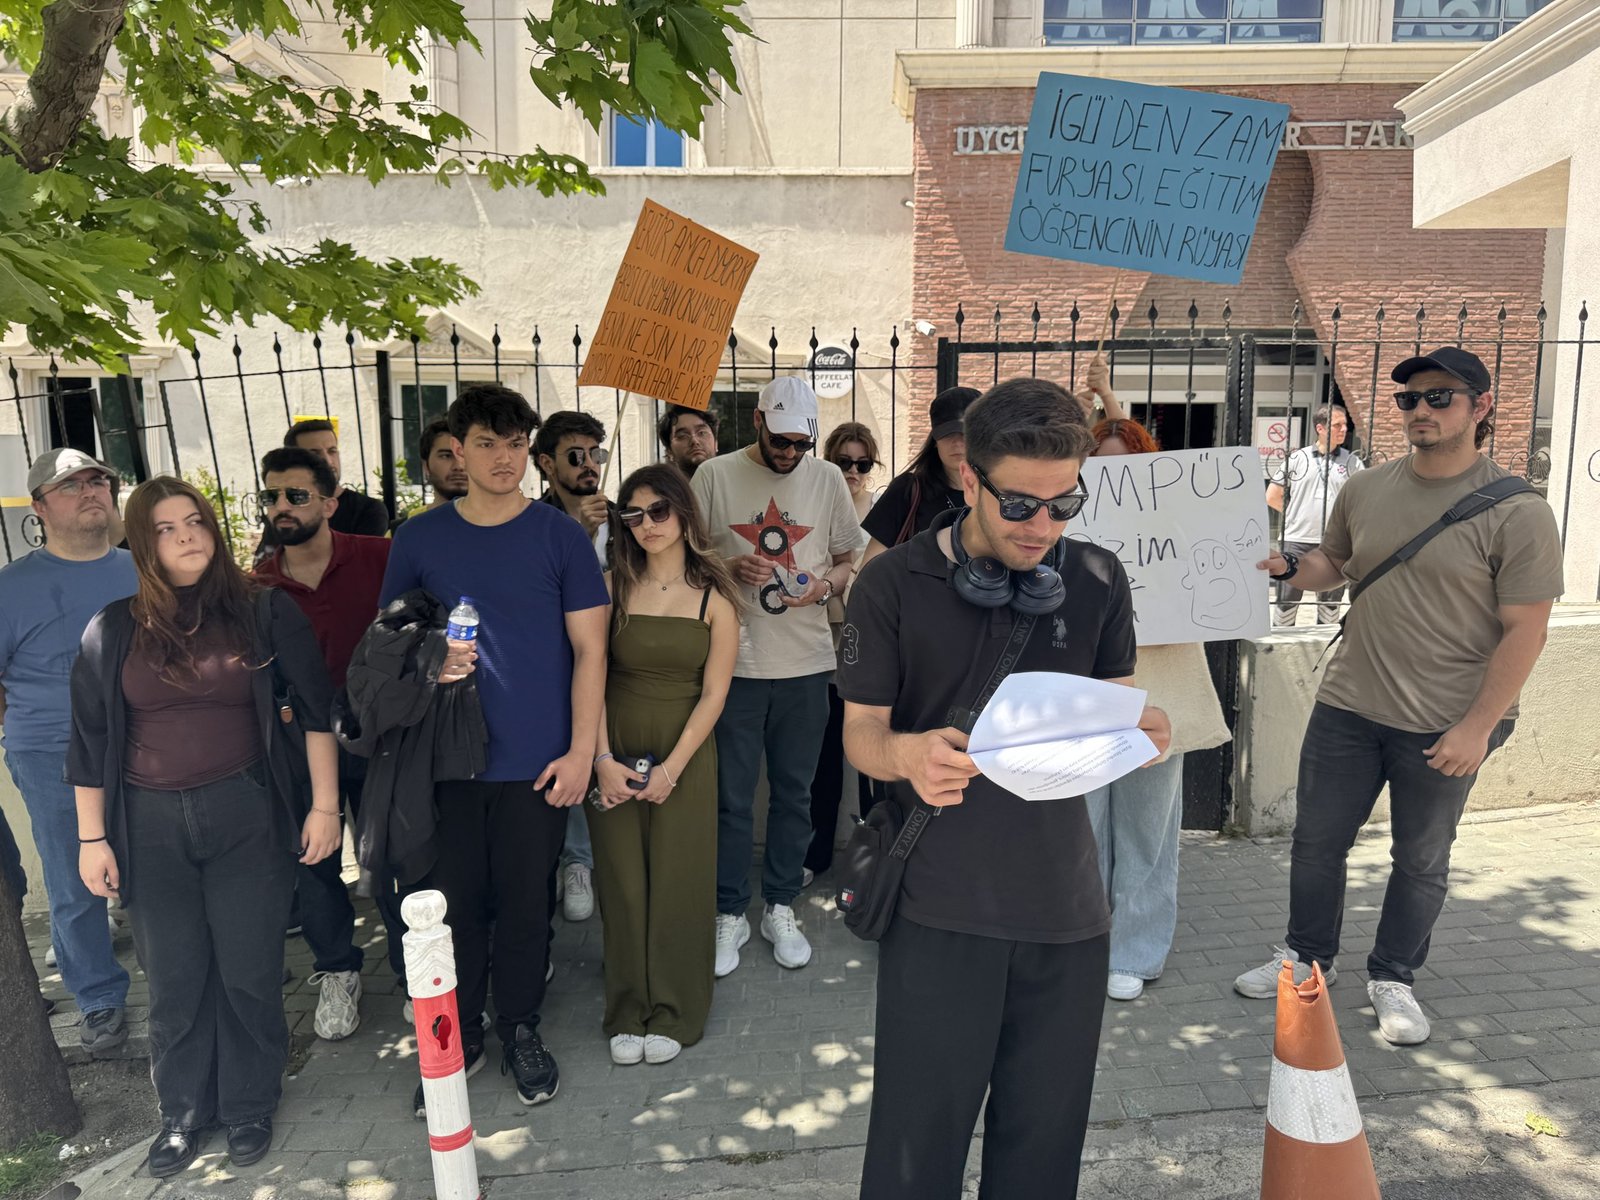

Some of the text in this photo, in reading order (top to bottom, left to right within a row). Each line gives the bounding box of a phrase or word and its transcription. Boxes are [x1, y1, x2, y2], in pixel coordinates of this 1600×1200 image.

[1194, 108, 1284, 166] ZAM
[1154, 167, 1267, 219] EĞİTİM
[666, 225, 712, 278] AMCA
[1018, 199, 1251, 271] ÖĞRENCİNİN RÜYASI
[622, 318, 648, 353] NE
[676, 287, 735, 336] OKUMASIN
[613, 355, 687, 401] KIRAATHANE
[1080, 452, 1246, 527] MPÜS
[843, 623, 859, 665] 3
[900, 808, 928, 847] TOMMY
